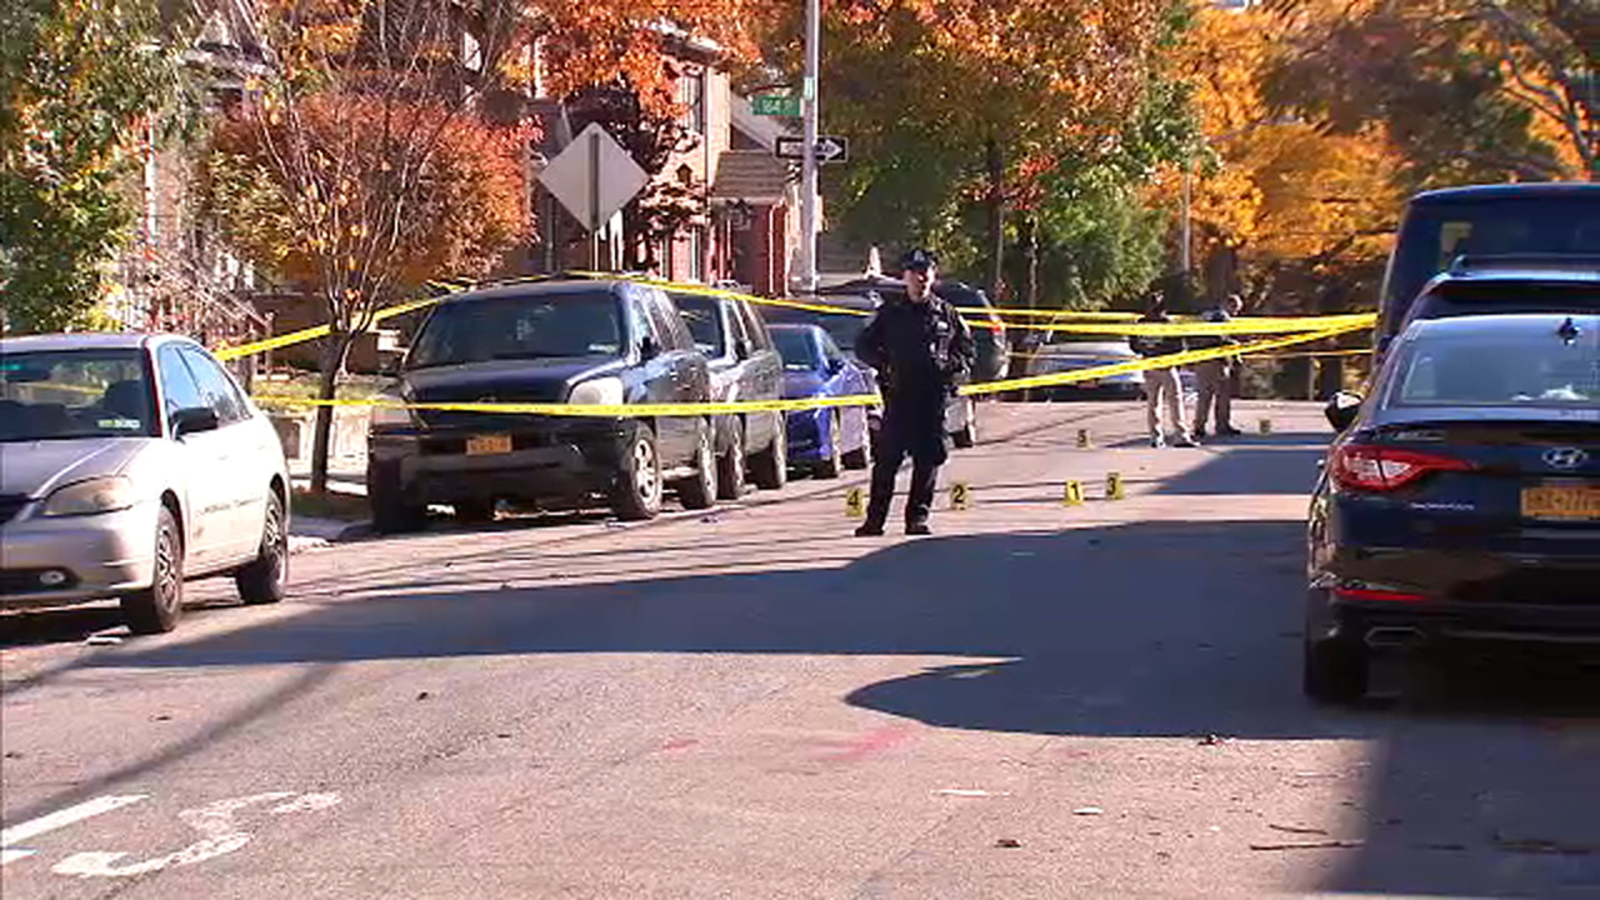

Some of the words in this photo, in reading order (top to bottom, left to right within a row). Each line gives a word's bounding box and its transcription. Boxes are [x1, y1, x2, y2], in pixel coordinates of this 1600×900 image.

[953, 484, 965, 503] 2
[1106, 477, 1117, 496] 3
[847, 489, 860, 509] 4
